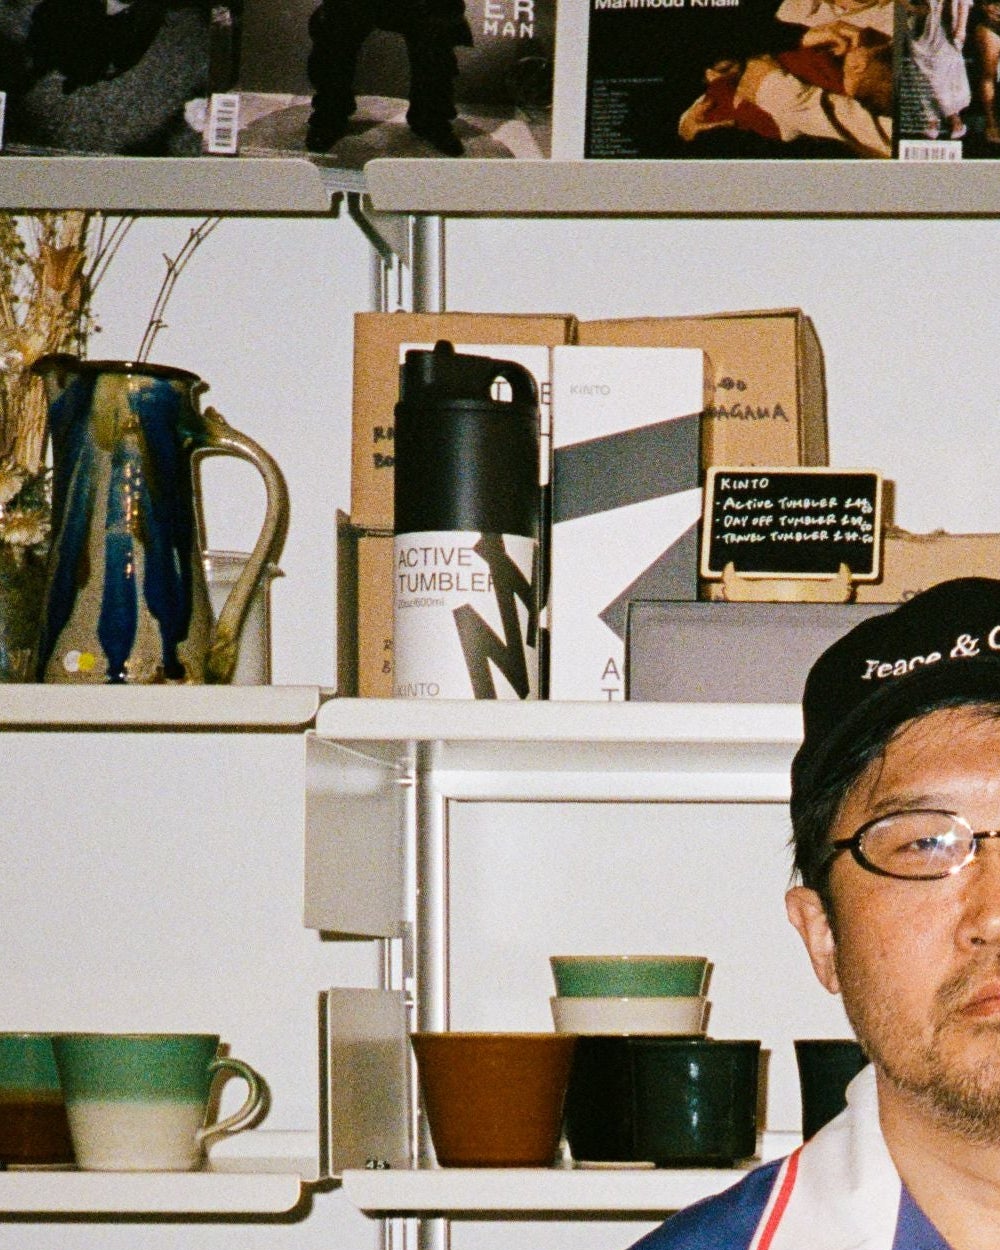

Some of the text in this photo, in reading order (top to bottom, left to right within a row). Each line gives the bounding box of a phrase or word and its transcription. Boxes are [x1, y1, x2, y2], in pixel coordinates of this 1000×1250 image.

[484, 21, 534, 39] MAN
[570, 385, 611, 395] KINTO
[721, 477, 769, 490] KINTO
[779, 497, 838, 509] TUMBLER
[724, 516, 746, 527] DAY
[752, 515, 773, 526] OFF
[779, 515, 836, 526] TUMBLER
[724, 533, 766, 544] TRAVEL
[771, 531, 829, 542] TUMBLER
[399, 547, 472, 567] ACTIVE
[861, 651, 942, 680] Peace
[950, 633, 981, 658] &
